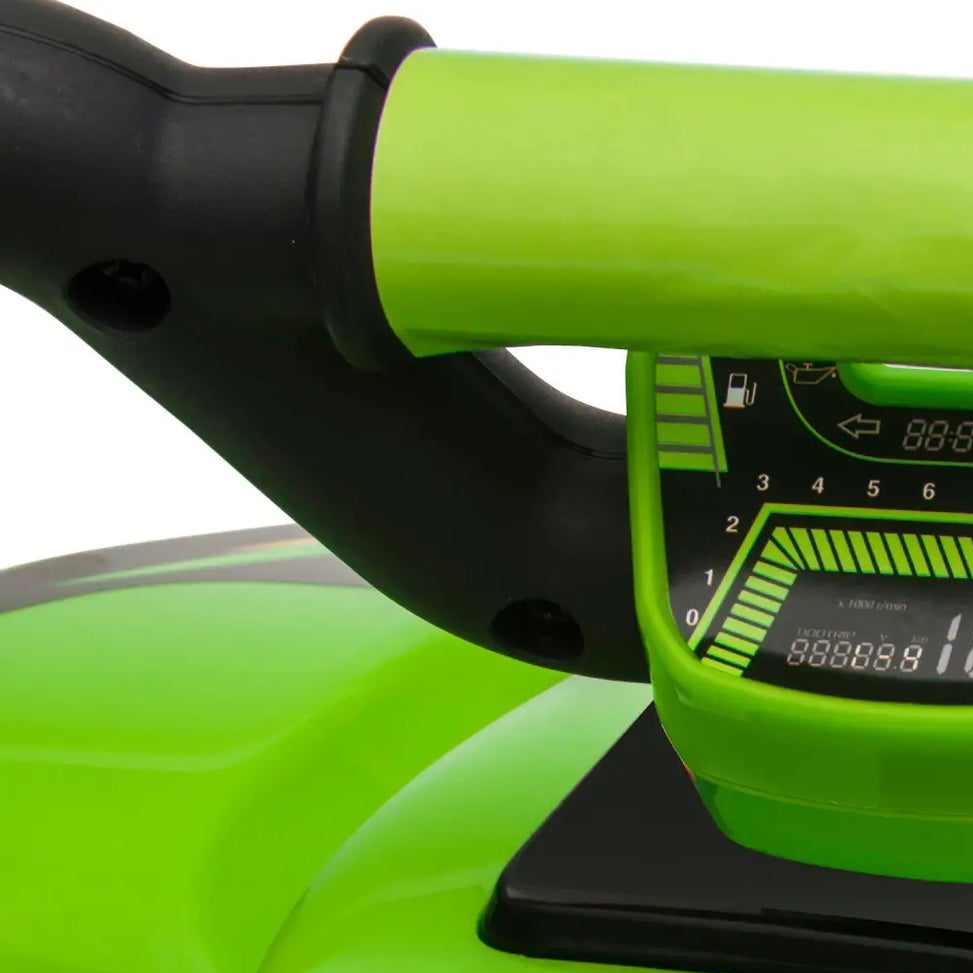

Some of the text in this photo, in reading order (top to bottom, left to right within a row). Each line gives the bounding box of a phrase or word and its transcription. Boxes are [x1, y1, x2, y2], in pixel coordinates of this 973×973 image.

[756, 473, 770, 491] 3
[811, 476, 825, 494] 4
[867, 479, 881, 497] 5
[922, 482, 936, 500] 6
[725, 515, 739, 533] 2
[704, 569, 714, 586] 1
[685, 608, 699, 626] 0
